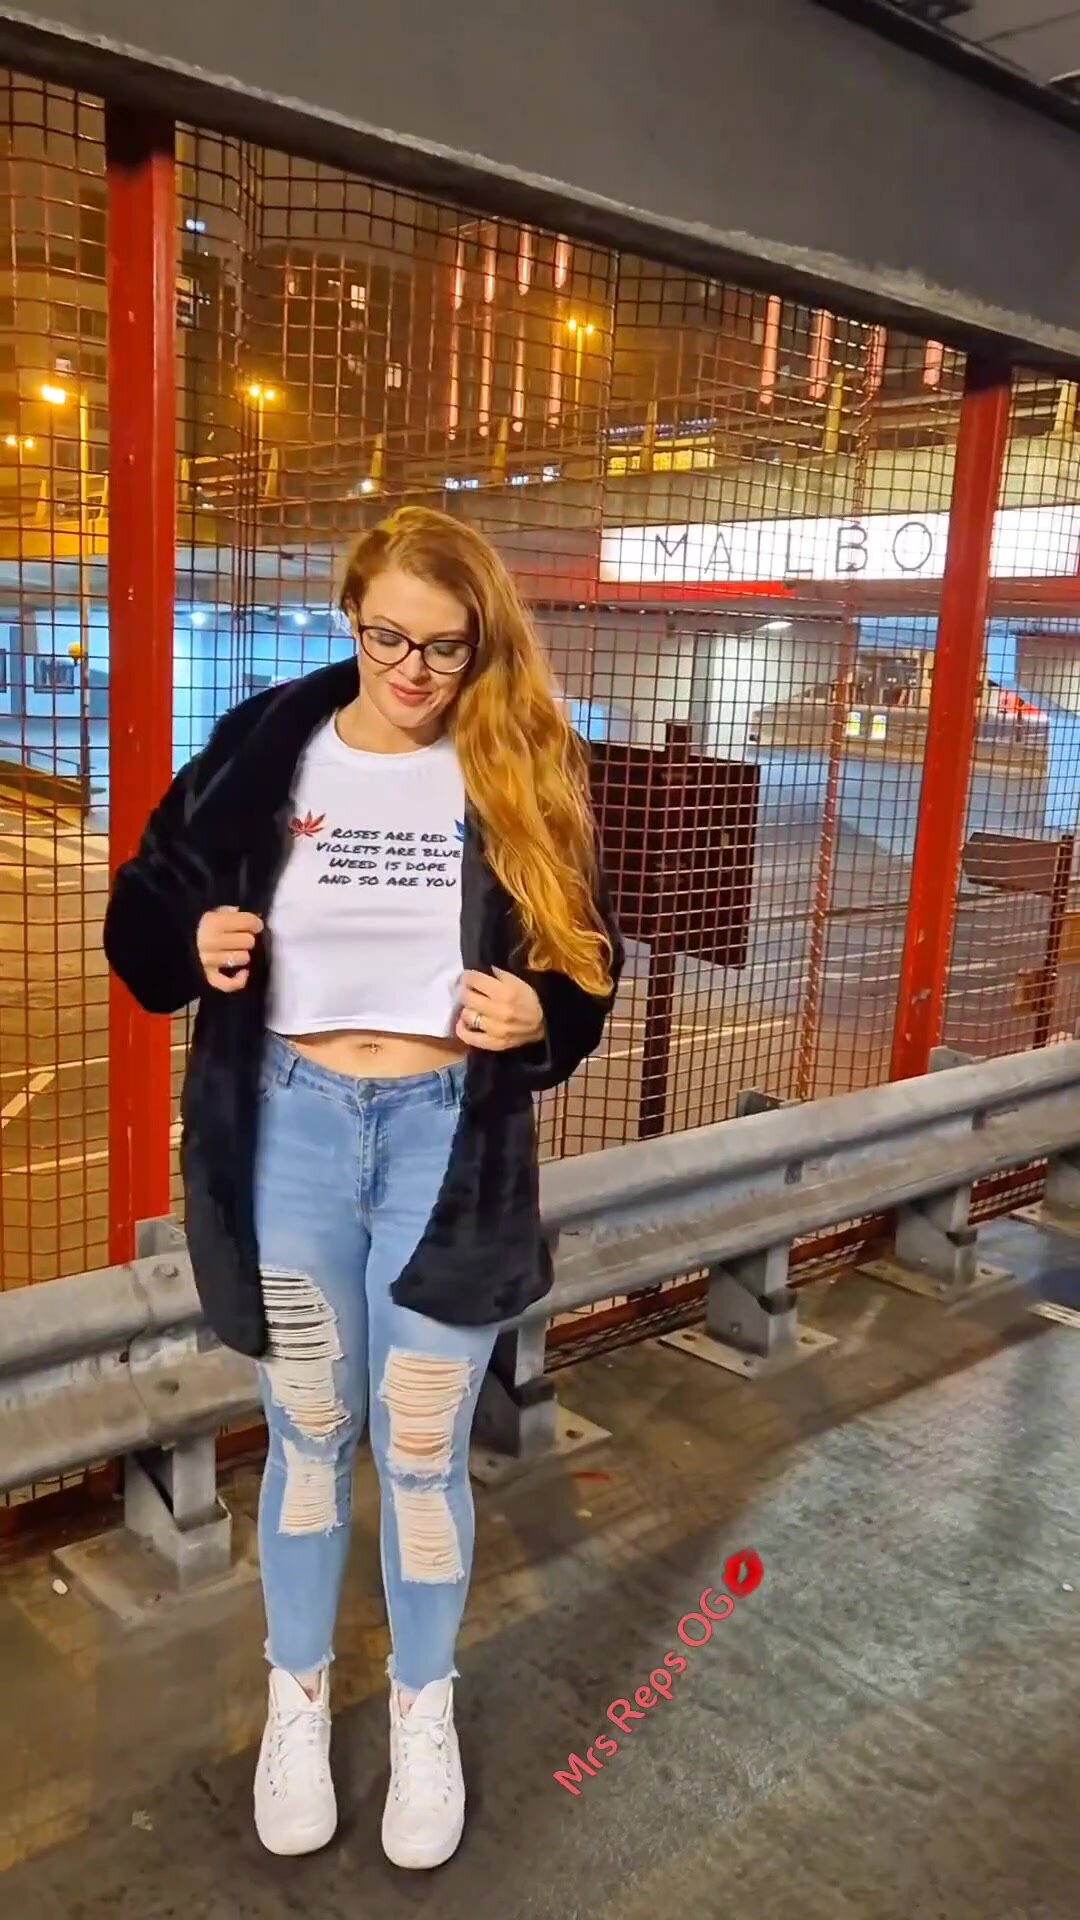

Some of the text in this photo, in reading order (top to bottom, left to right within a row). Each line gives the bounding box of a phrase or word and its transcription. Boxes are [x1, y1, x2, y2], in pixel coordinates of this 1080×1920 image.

[653, 521, 934, 577] MAILBO
[331, 827, 448, 843] ROSES ARE RED
[316, 842, 462, 858] VIOLETS ARE BLUE
[329, 857, 448, 872] WEED IS DOPE
[318, 875, 457, 888] AND SO ARE YOU
